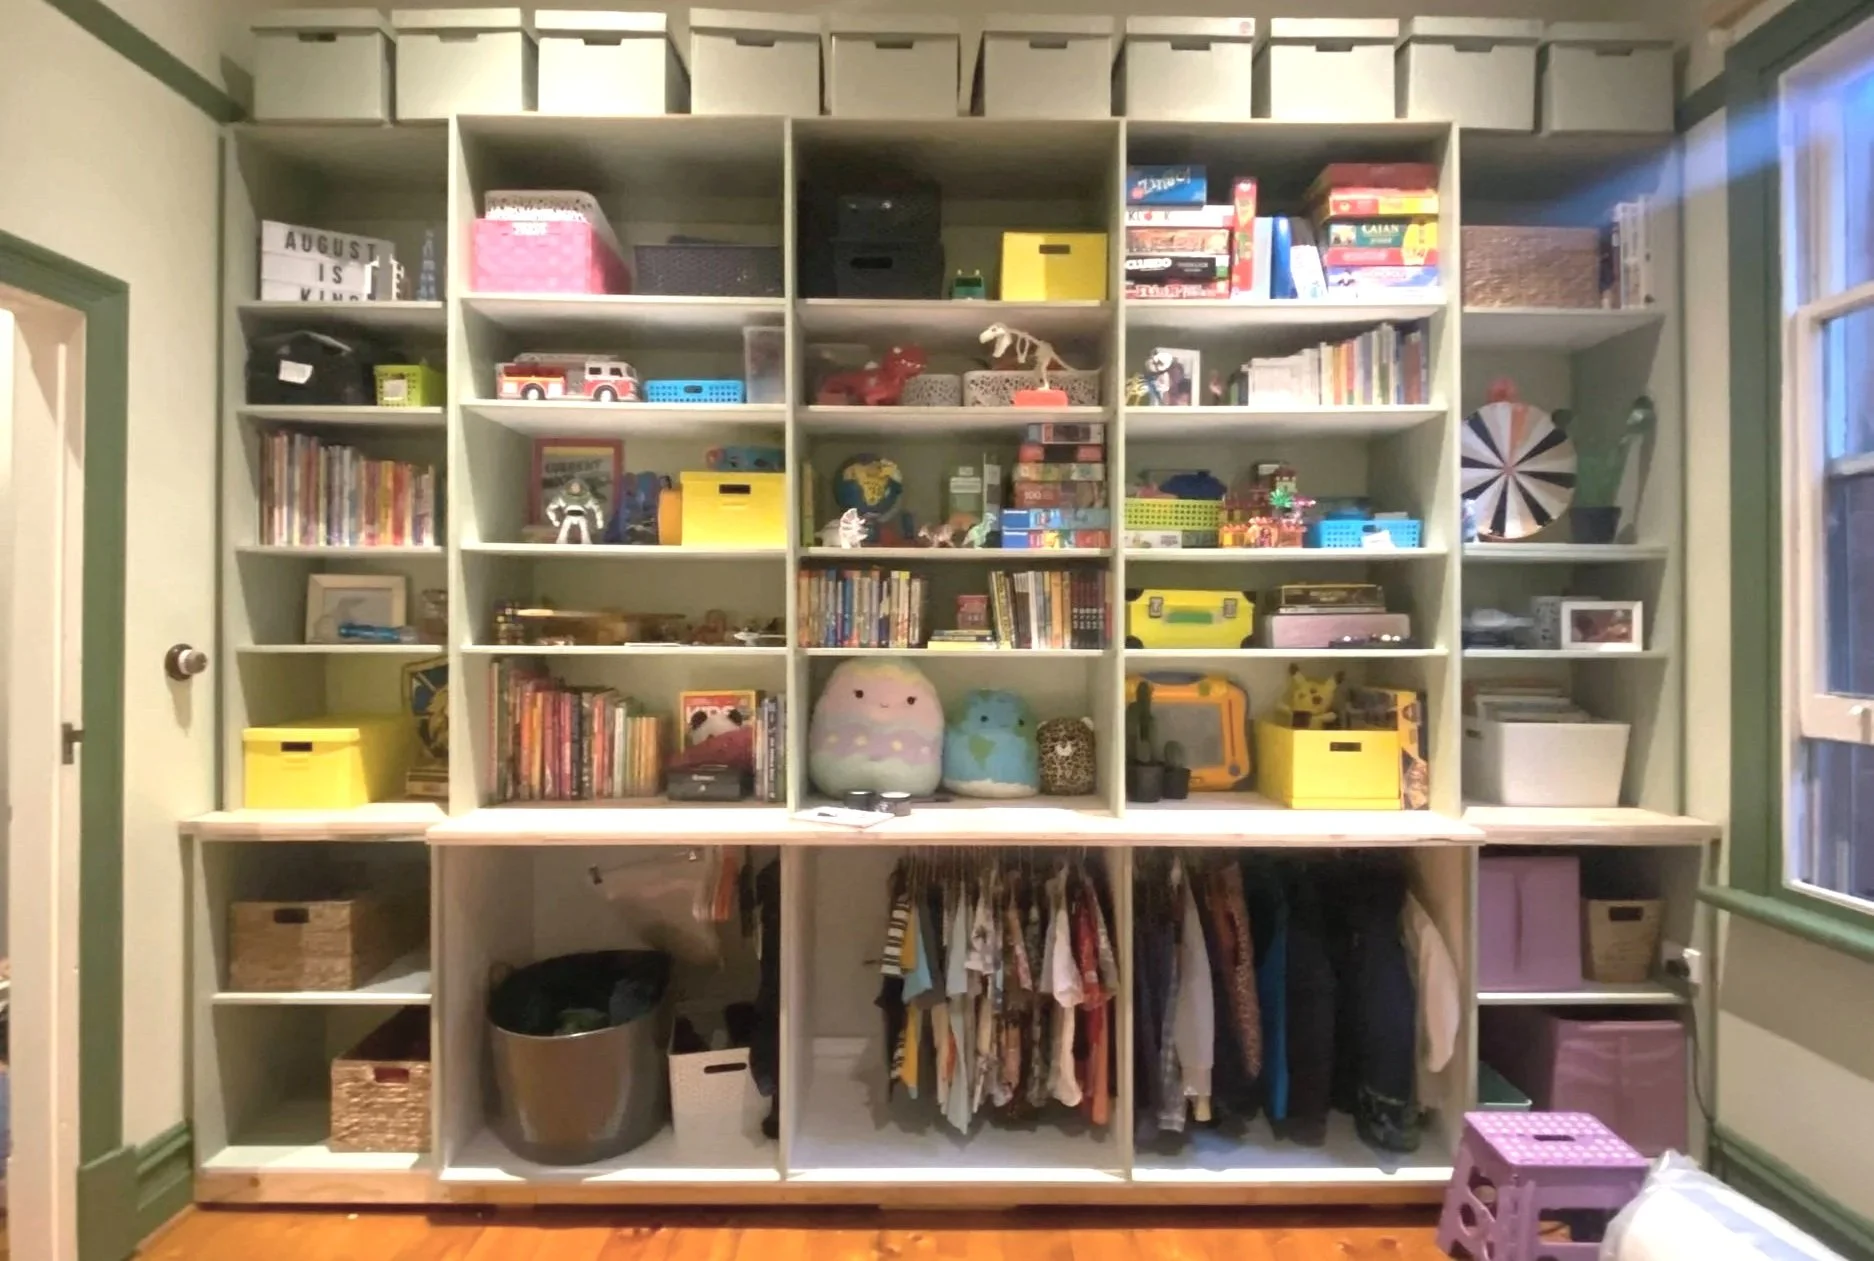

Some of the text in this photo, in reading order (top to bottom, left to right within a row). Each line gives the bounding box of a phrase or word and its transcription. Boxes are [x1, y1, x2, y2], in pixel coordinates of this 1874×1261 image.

[1361, 224, 1400, 234] CATAN
[285, 231, 377, 261] AUGUST
[319, 263, 343, 284] IS
